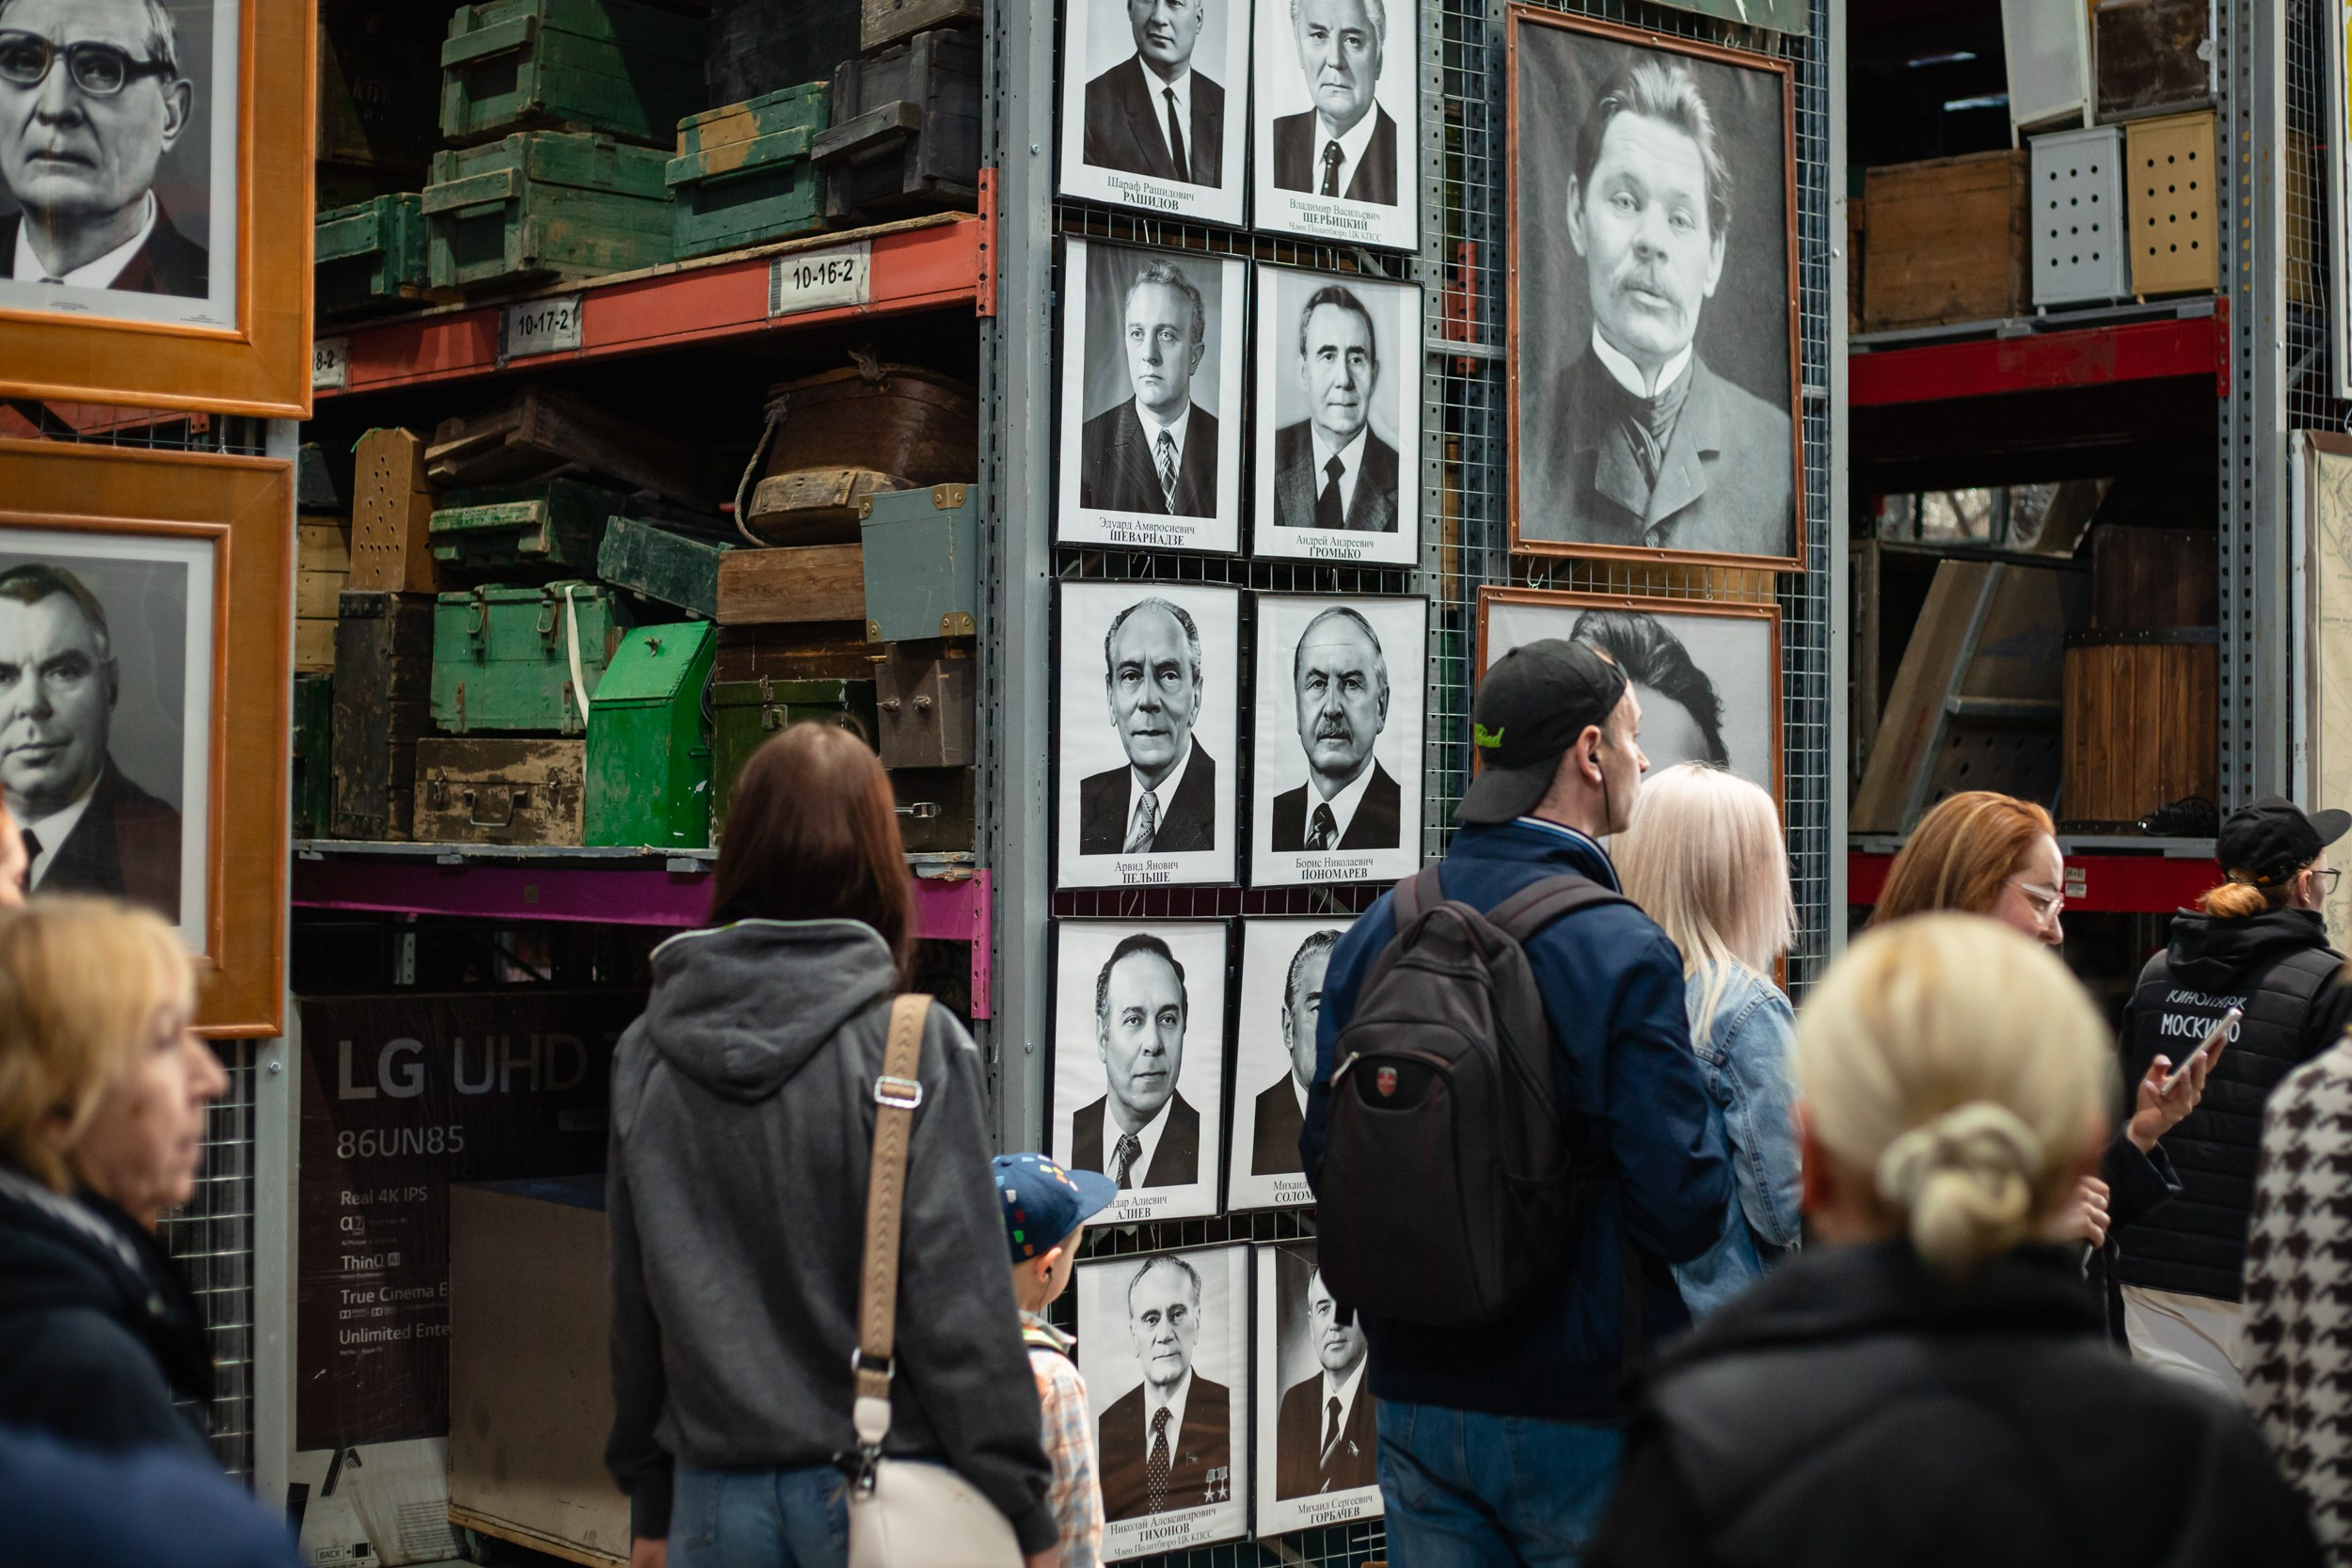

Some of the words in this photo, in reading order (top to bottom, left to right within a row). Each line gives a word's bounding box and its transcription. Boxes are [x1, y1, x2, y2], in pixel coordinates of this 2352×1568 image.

[1108, 176, 1141, 194] Шараф
[1143, 182, 1195, 201] Рашидович
[1122, 191, 1179, 211] РАШИДОВ
[1289, 198, 1331, 214] Владимир
[1333, 204, 1381, 221] Васильевич
[1303, 213, 1368, 230] ЩЕРБИЦКИЙ
[1289, 221, 1307, 232] Член
[1308, 225, 1348, 239] Политбюро
[1348, 230, 1360, 241] ЦК
[1360, 232, 1382, 243] КПСС
[793, 259, 854, 290] 10-16-2
[518, 309, 568, 336] 10-17-2
[1099, 516, 1133, 532] Эдуард
[1134, 520, 1196, 535] Амвросиевич
[1109, 530, 1184, 546] ШЕВАРНАДЗЕ
[1295, 534, 1327, 549] Андрей
[1329, 536, 1375, 549] Андреевич
[1309, 546, 1361, 559] ГРОМЫКО
[1114, 861, 1143, 874] Арвид
[1145, 860, 1179, 870] Янович
[1295, 857, 1322, 871] Борис
[1324, 857, 1374, 867] Николаевич
[1301, 867, 1368, 880] ПОНОМАРЕВ
[1122, 872, 1170, 884] ПЕЛЬШЕ
[2160, 1013, 2241, 1043] МОСКИО
[339, 1037, 425, 1101] LG
[453, 1033, 588, 1095] UHD
[337, 1125, 465, 1159] 86UN85
[1273, 1180, 1308, 1191] Михаил
[341, 1190, 373, 1206] Real
[378, 1188, 400, 1203] 4K
[404, 1186, 428, 1202] IPS
[1131, 1196, 1168, 1207] Алиевич
[1116, 1207, 1152, 1220] АЛИЕВ
[341, 1253, 385, 1271] ThinQ
[341, 1289, 375, 1305] True
[379, 1286, 435, 1302] Cinema
[340, 1326, 411, 1345] Unlimited
[1297, 1502, 1329, 1514] Михаил
[1331, 1495, 1373, 1510] Сергеевич
[1110, 1518, 1149, 1535] Николай
[1150, 1507, 1216, 1528] Александрович
[1311, 1507, 1360, 1525] ГОРБАЧЕВ
[1137, 1523, 1190, 1543] ТИХОНОВ
[1114, 1547, 1135, 1557] Член
[1135, 1539, 1177, 1554] Политбюро
[1178, 1535, 1190, 1545] ЦК
[1191, 1529, 1214, 1542] КПСС
[320, 1549, 341, 1560] BACK
